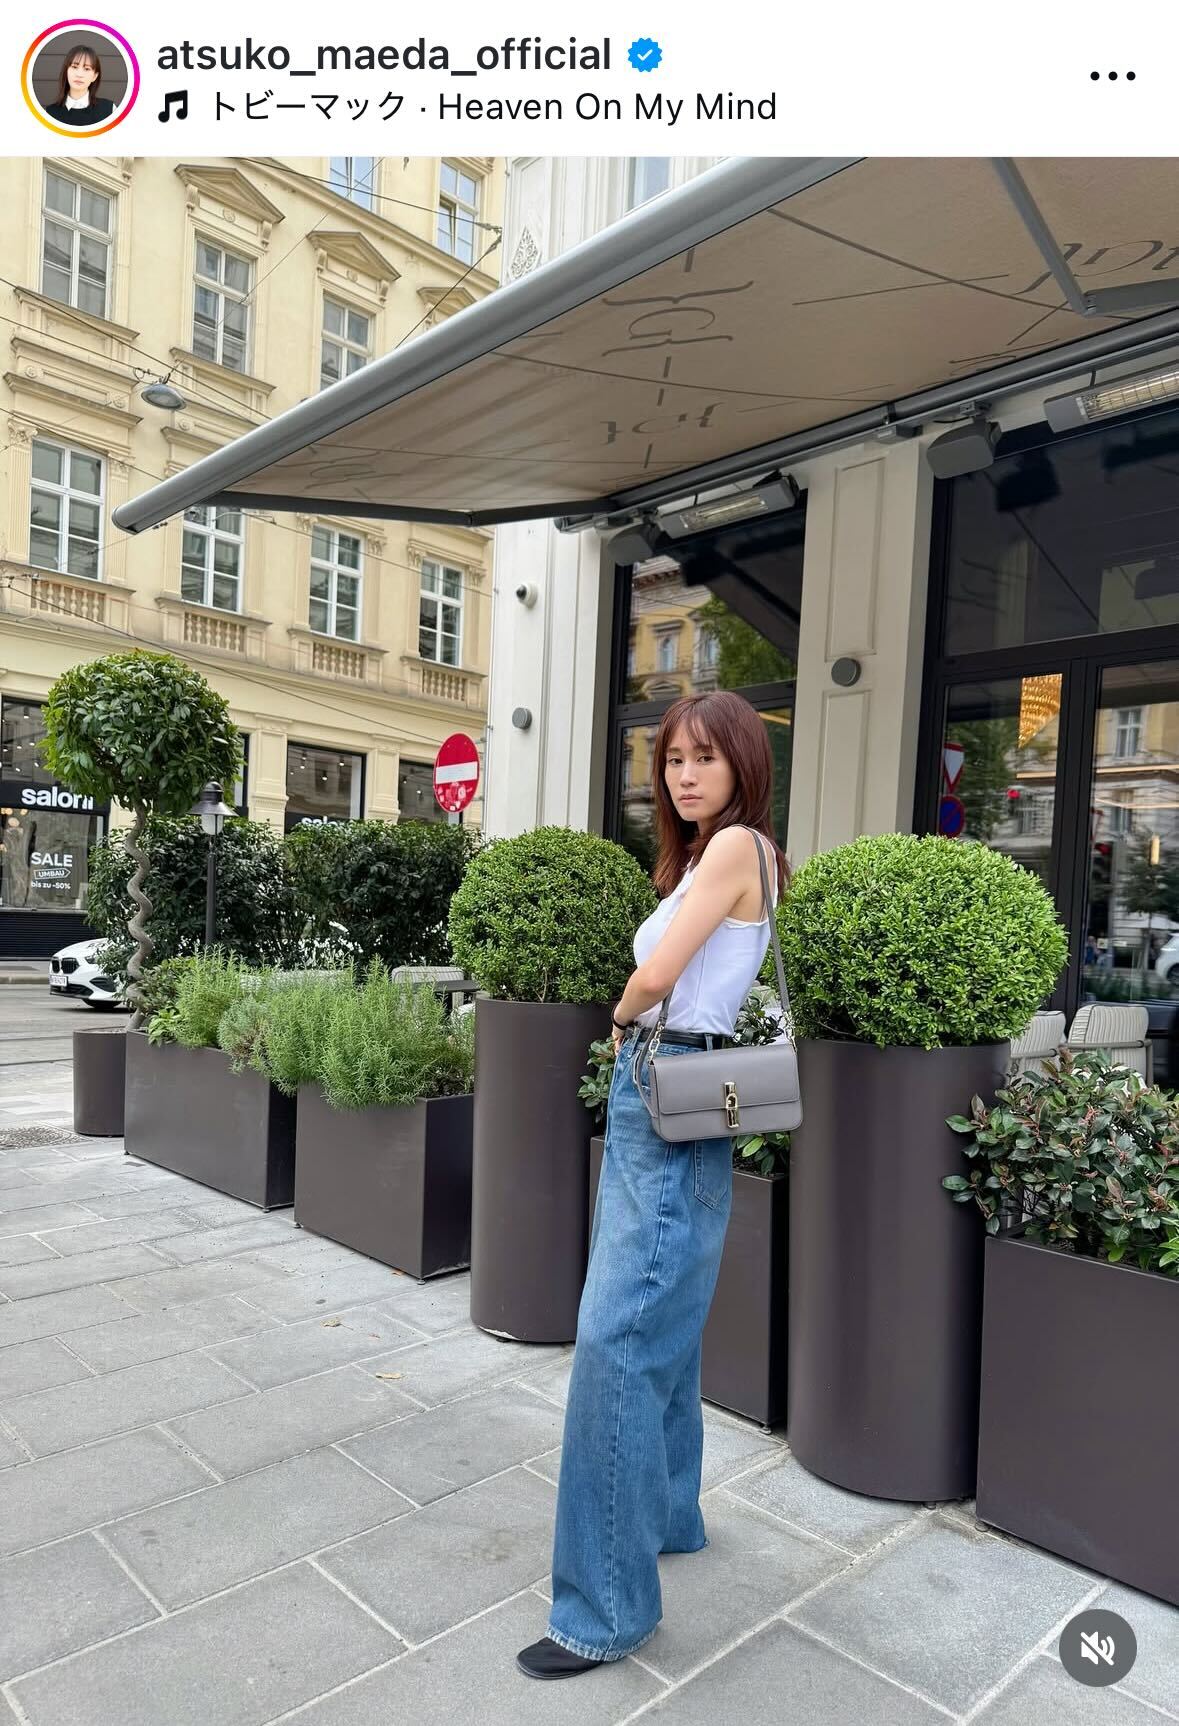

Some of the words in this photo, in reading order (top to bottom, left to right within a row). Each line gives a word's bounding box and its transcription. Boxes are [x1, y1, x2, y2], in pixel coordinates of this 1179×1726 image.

[31, 852, 73, 867] SALE
[38, 870, 65, 878] UMBAU
[31, 881, 42, 889] bis
